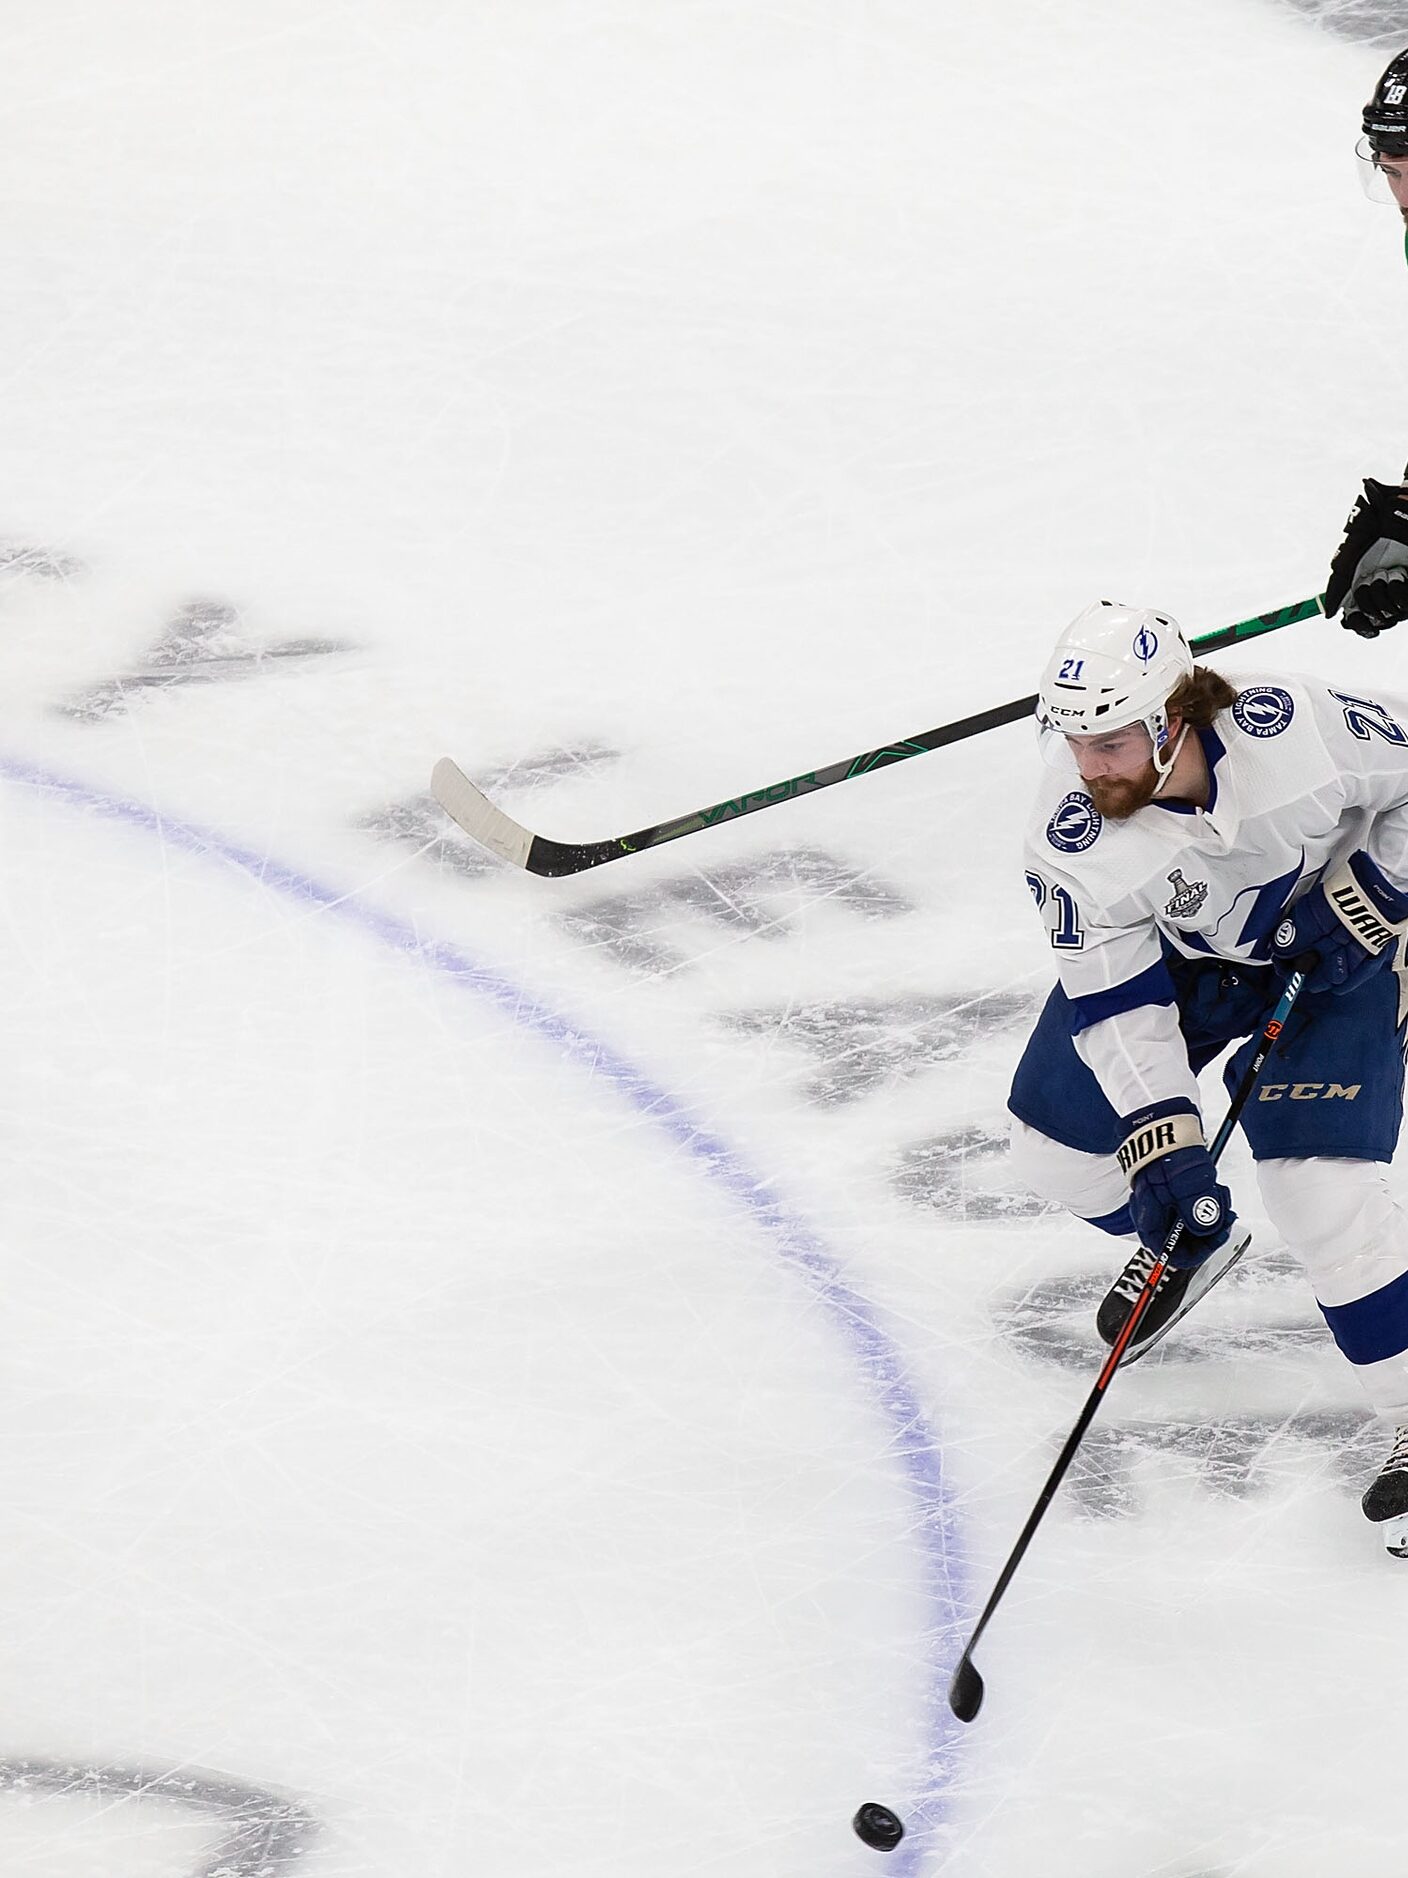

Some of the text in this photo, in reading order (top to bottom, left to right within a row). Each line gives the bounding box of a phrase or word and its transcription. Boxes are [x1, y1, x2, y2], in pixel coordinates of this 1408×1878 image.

[1383, 84, 1408, 105] 18
[1058, 659, 1085, 681] 21
[1050, 706, 1085, 717] CCM
[1234, 687, 1273, 716] LIGHTNING
[1236, 717, 1255, 733] BAY
[1255, 719, 1288, 736] TAMPA
[700, 771, 825, 825] VAPOR
[1069, 793, 1087, 804] BAY
[1075, 802, 1101, 850] LIGHTNING
[1164, 881, 1208, 914] FINAL
[1373, 884, 1395, 902] POINT
[1252, 1053, 1265, 1073] POINT
[1258, 1083, 1362, 1101] CCM
[1131, 1112, 1155, 1126] POINT
[1166, 1218, 1185, 1252] OVERT
